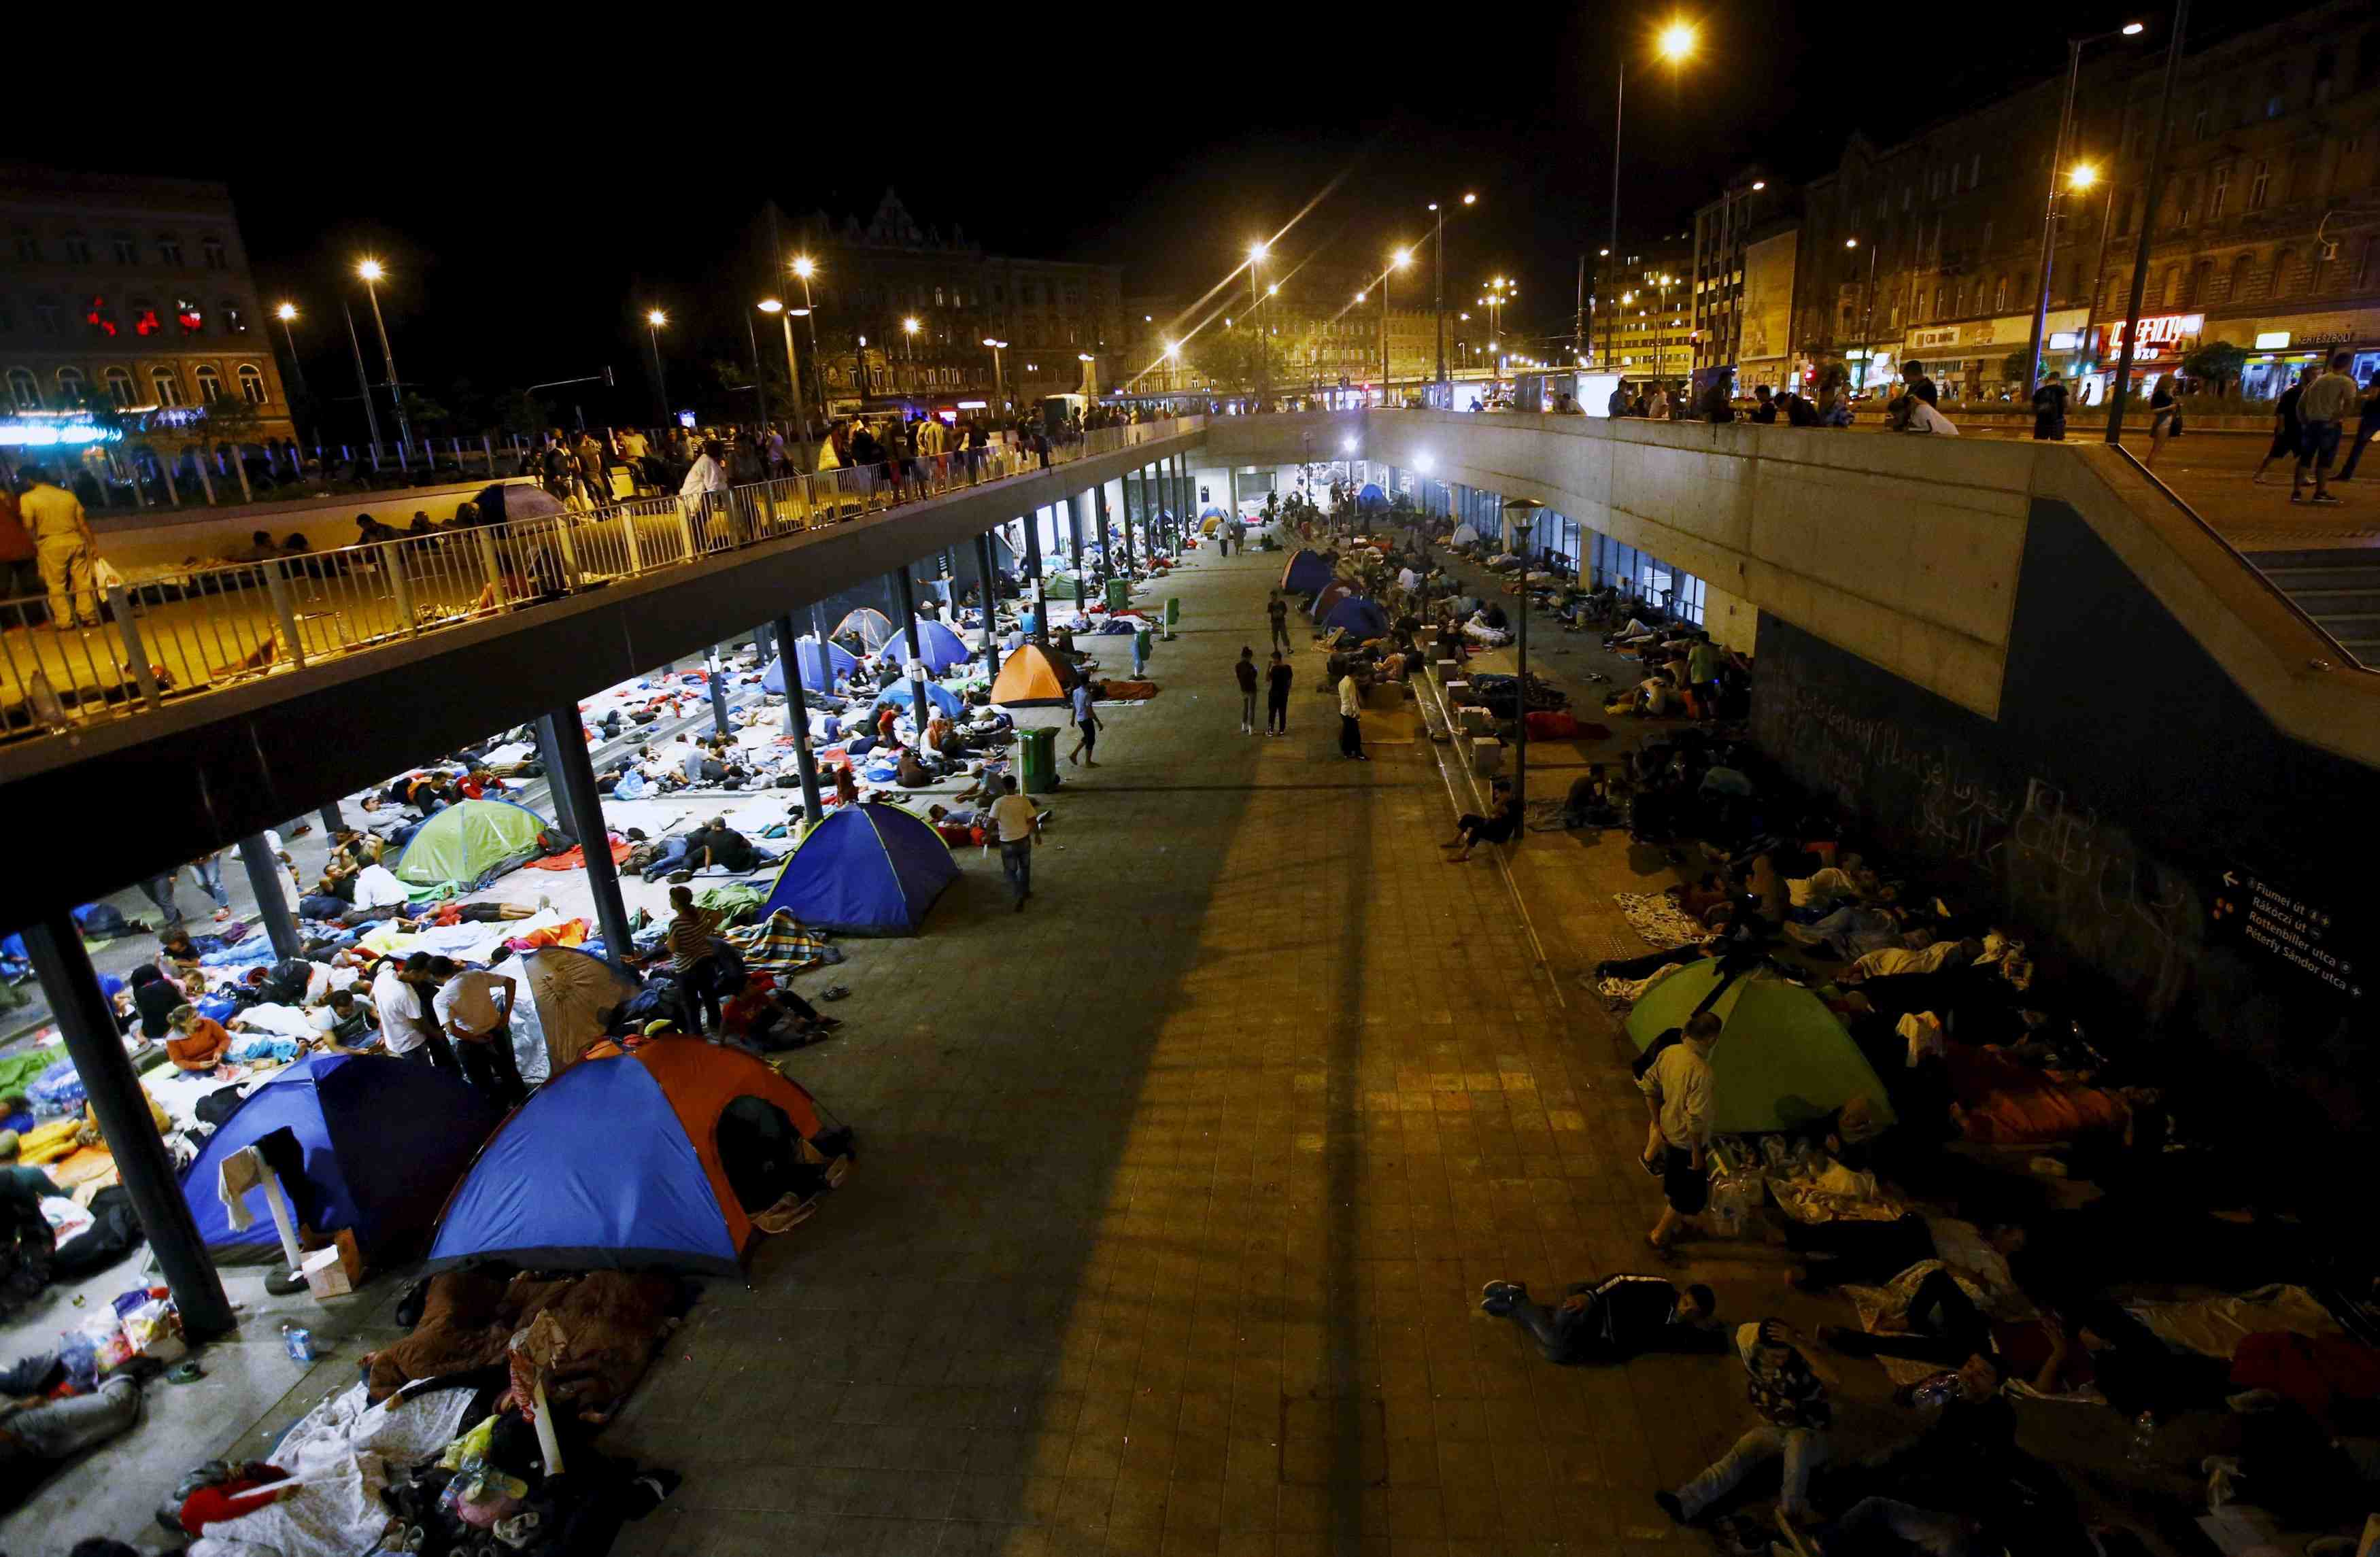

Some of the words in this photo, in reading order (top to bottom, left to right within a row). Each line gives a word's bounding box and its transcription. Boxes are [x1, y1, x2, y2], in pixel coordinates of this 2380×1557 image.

[2253, 896, 2292, 925] Rákóczi
[2294, 920, 2307, 934] út
[2256, 881, 2291, 908] Fiumei
[2293, 901, 2307, 915] út
[2245, 925, 2280, 953] Péterfy
[2283, 946, 2319, 974] Sándor
[2321, 971, 2347, 990] utca
[2249, 911, 2311, 951] Rottenbiller
[2311, 946, 2337, 968] utca
